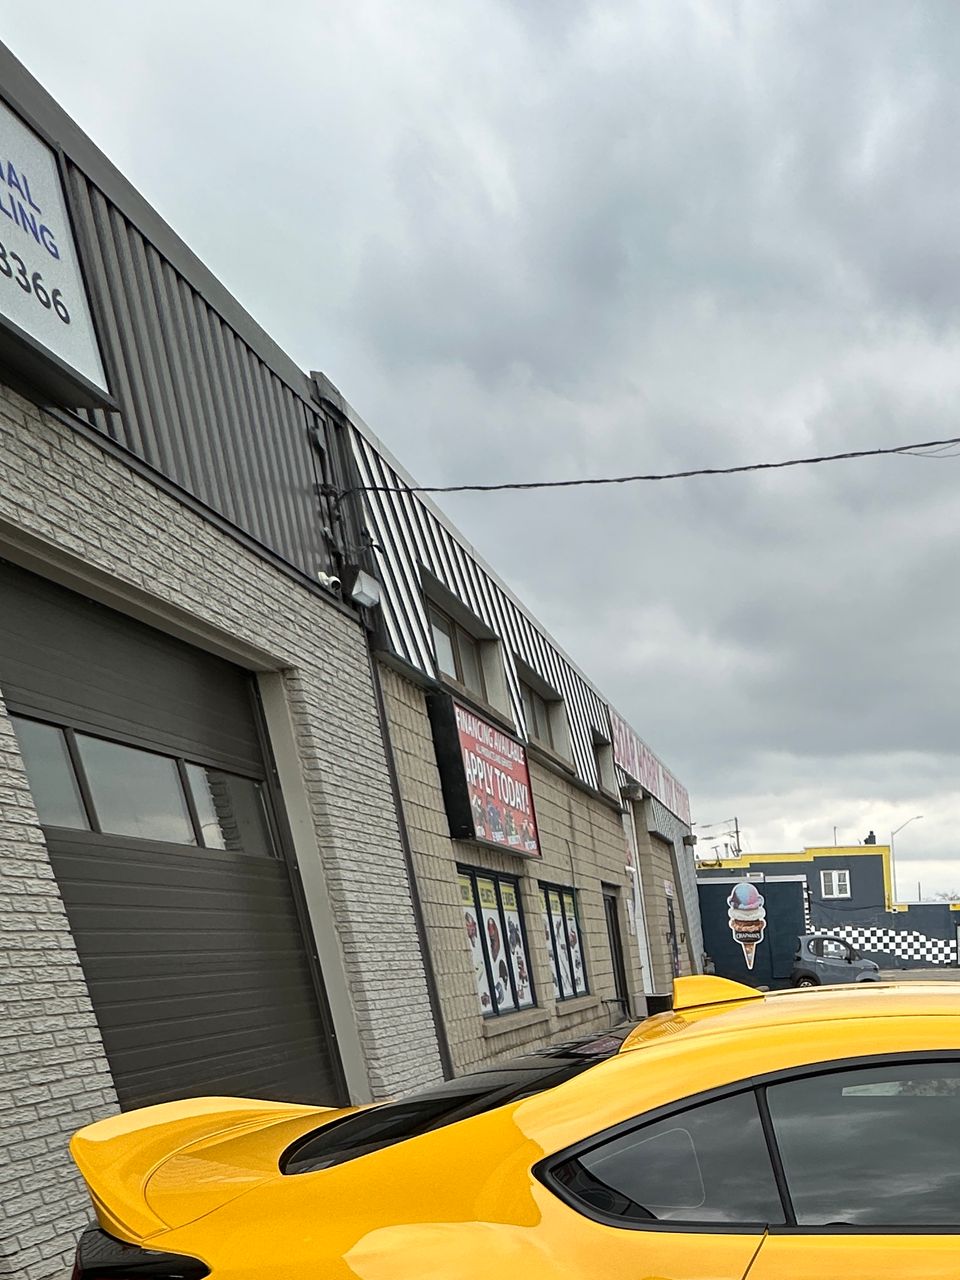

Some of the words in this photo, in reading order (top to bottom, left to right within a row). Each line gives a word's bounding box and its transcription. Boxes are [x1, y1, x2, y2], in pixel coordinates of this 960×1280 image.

[0, 159, 42, 215] AL
[455, 707, 494, 748] FINANCING
[494, 730, 526, 766] AVAILABLE
[464, 748, 495, 797] APPLY
[495, 768, 530, 815] TODAY!
